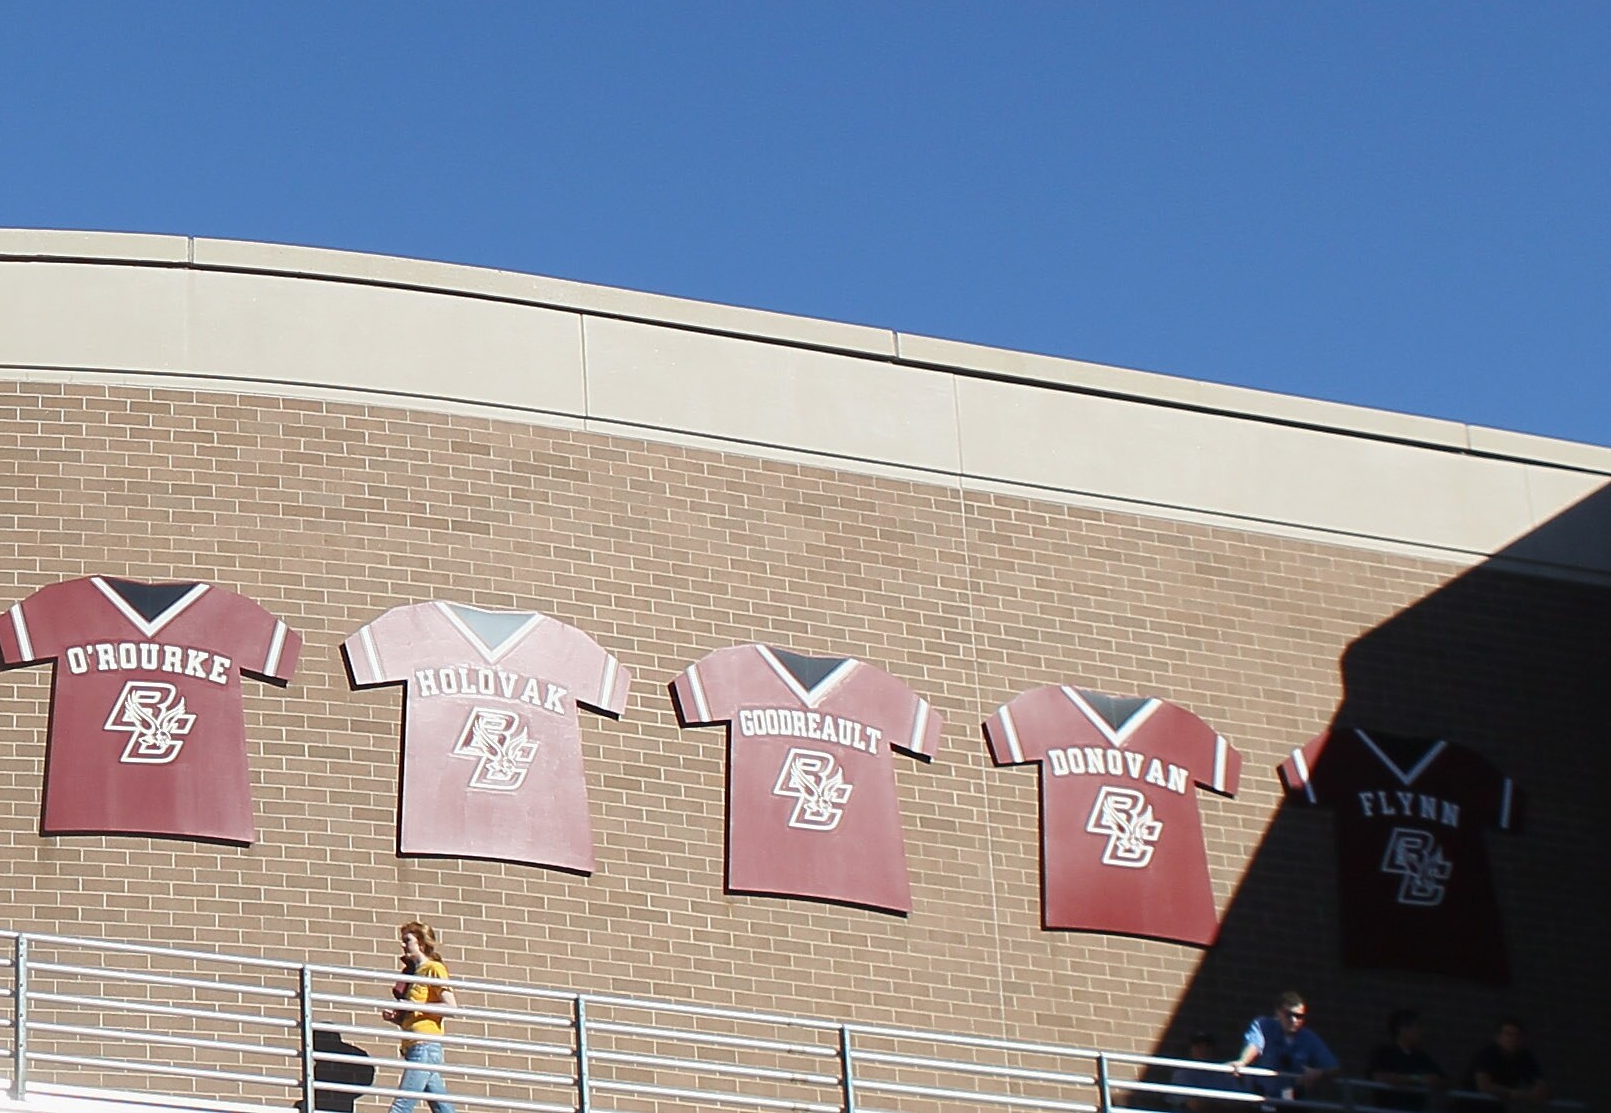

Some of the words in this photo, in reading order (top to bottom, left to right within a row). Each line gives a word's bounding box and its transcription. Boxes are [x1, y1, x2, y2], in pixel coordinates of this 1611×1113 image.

[67, 643, 231, 685] O'ROURKE
[416, 669, 567, 714] HOLOVAK
[740, 709, 882, 753] GOODREAULT
[1046, 748, 1189, 795] DONOVAN
[1359, 791, 1459, 826] FLYNN
